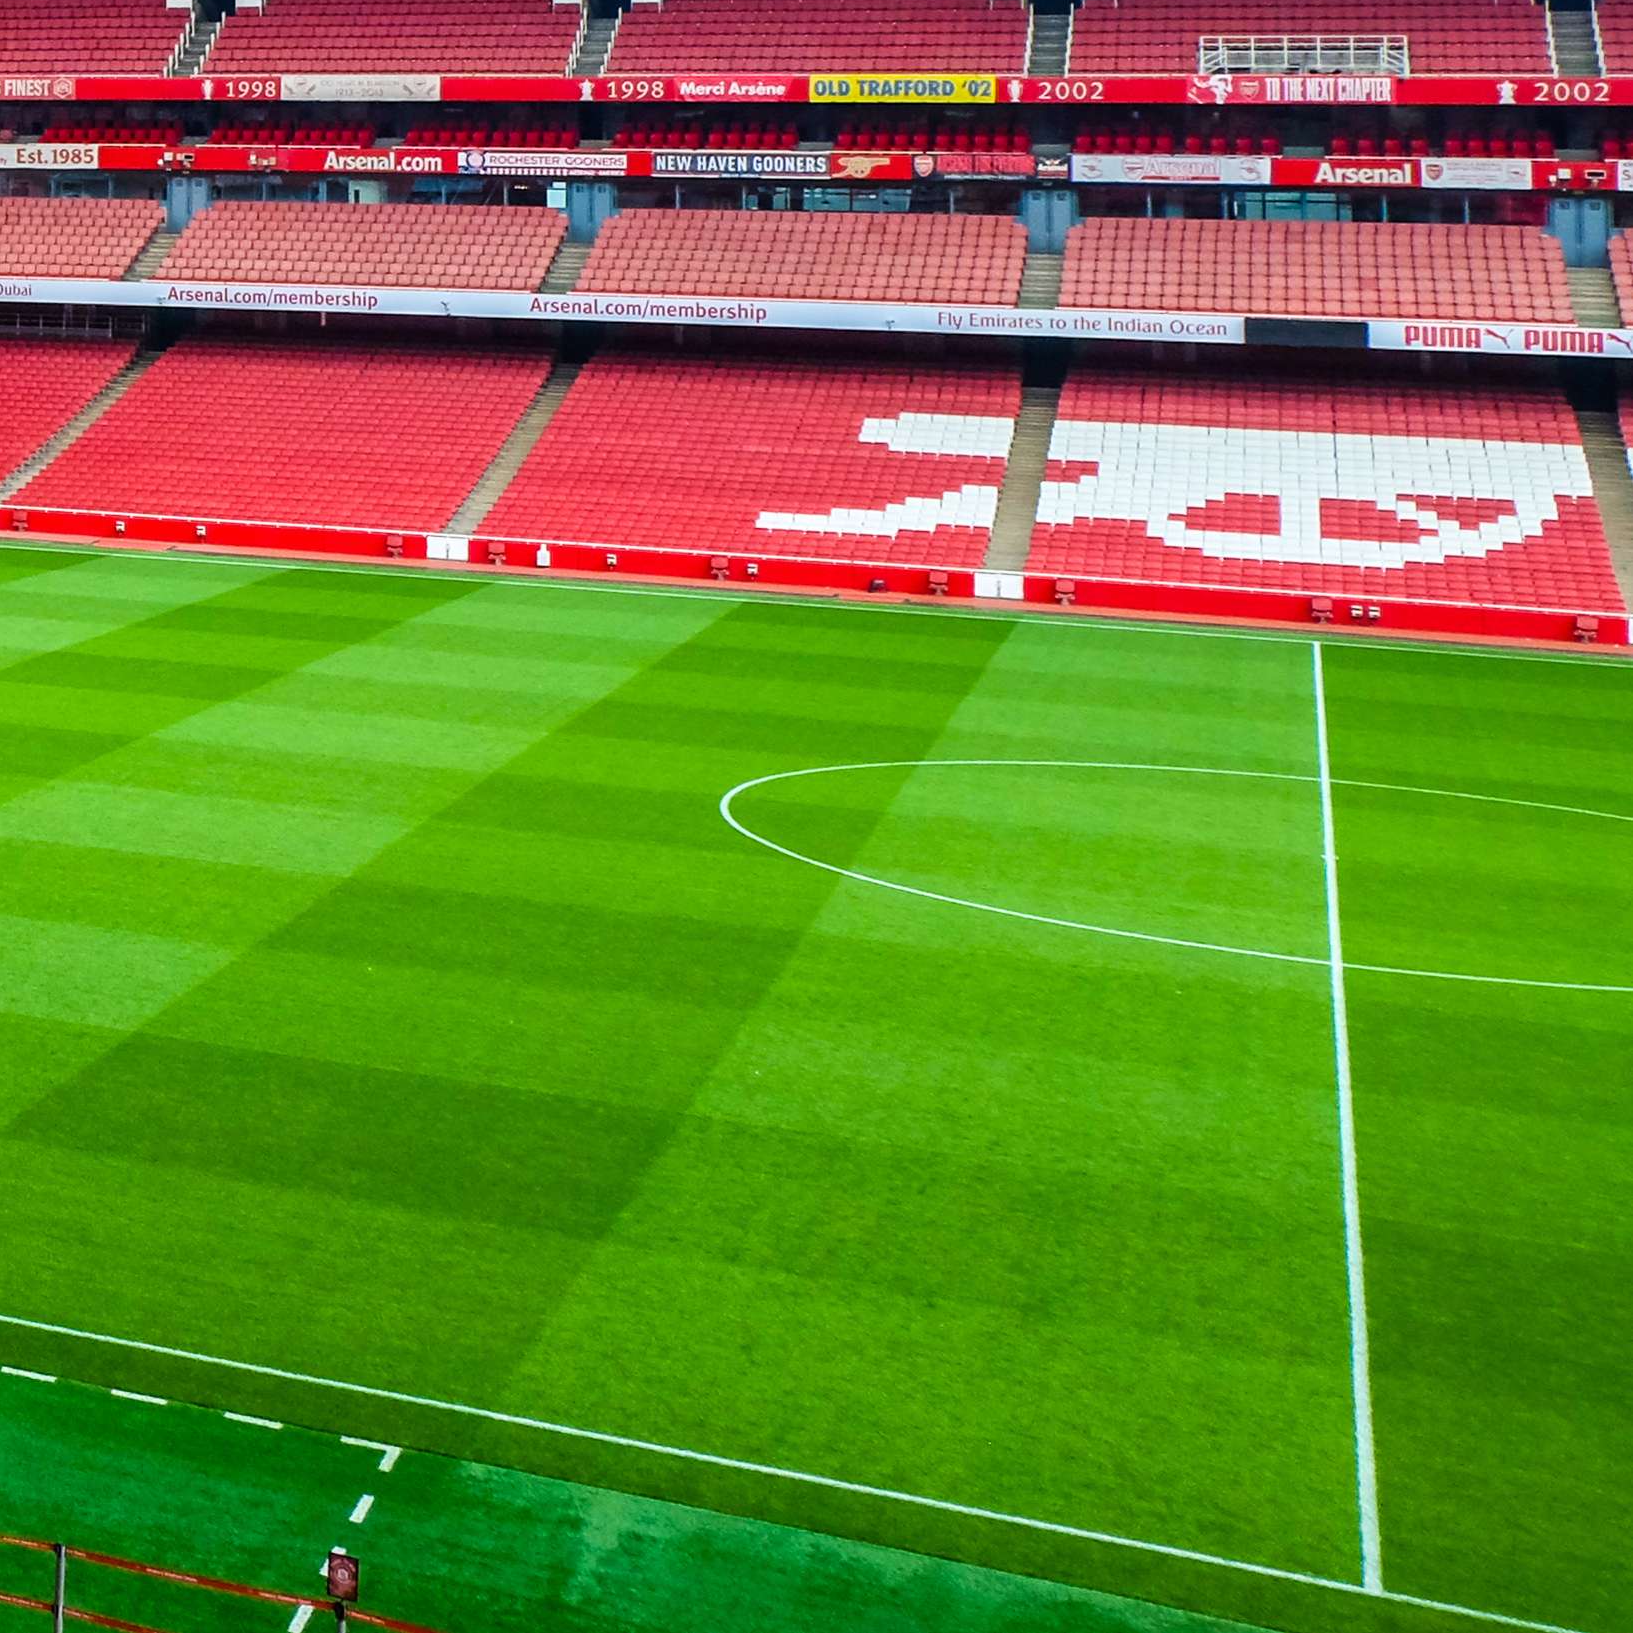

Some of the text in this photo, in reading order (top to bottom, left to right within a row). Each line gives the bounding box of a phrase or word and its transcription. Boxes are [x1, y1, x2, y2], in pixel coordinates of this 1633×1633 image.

[4, 79, 51, 96] FINEST
[226, 80, 277, 97] 1998
[607, 81, 665, 98] 1998
[680, 79, 786, 96] Merci Arsène
[815, 80, 849, 97] OLD
[856, 79, 954, 96] TRAFFORD
[1039, 81, 1104, 100] 2002
[1265, 77, 1392, 102] TO THE NEXT CHAPTER
[1534, 82, 1611, 102] 2002
[50, 148, 94, 164] 1985
[324, 151, 442, 172] Arsenal.com
[489, 155, 625, 167] ROCHESTER GOONERS
[655, 155, 827, 174] NEW HAVEN GOONERS
[1146, 157, 1220, 176] Arsenal
[1314, 162, 1412, 184] Arsenal
[167, 286, 378, 309] Arsenal.com/membership
[530, 297, 767, 324] Arsenal.com/membership
[937, 311, 1227, 336] Fly Emirates to the Indian Ocean
[1404, 325, 1604, 354] PUMA PUMA
